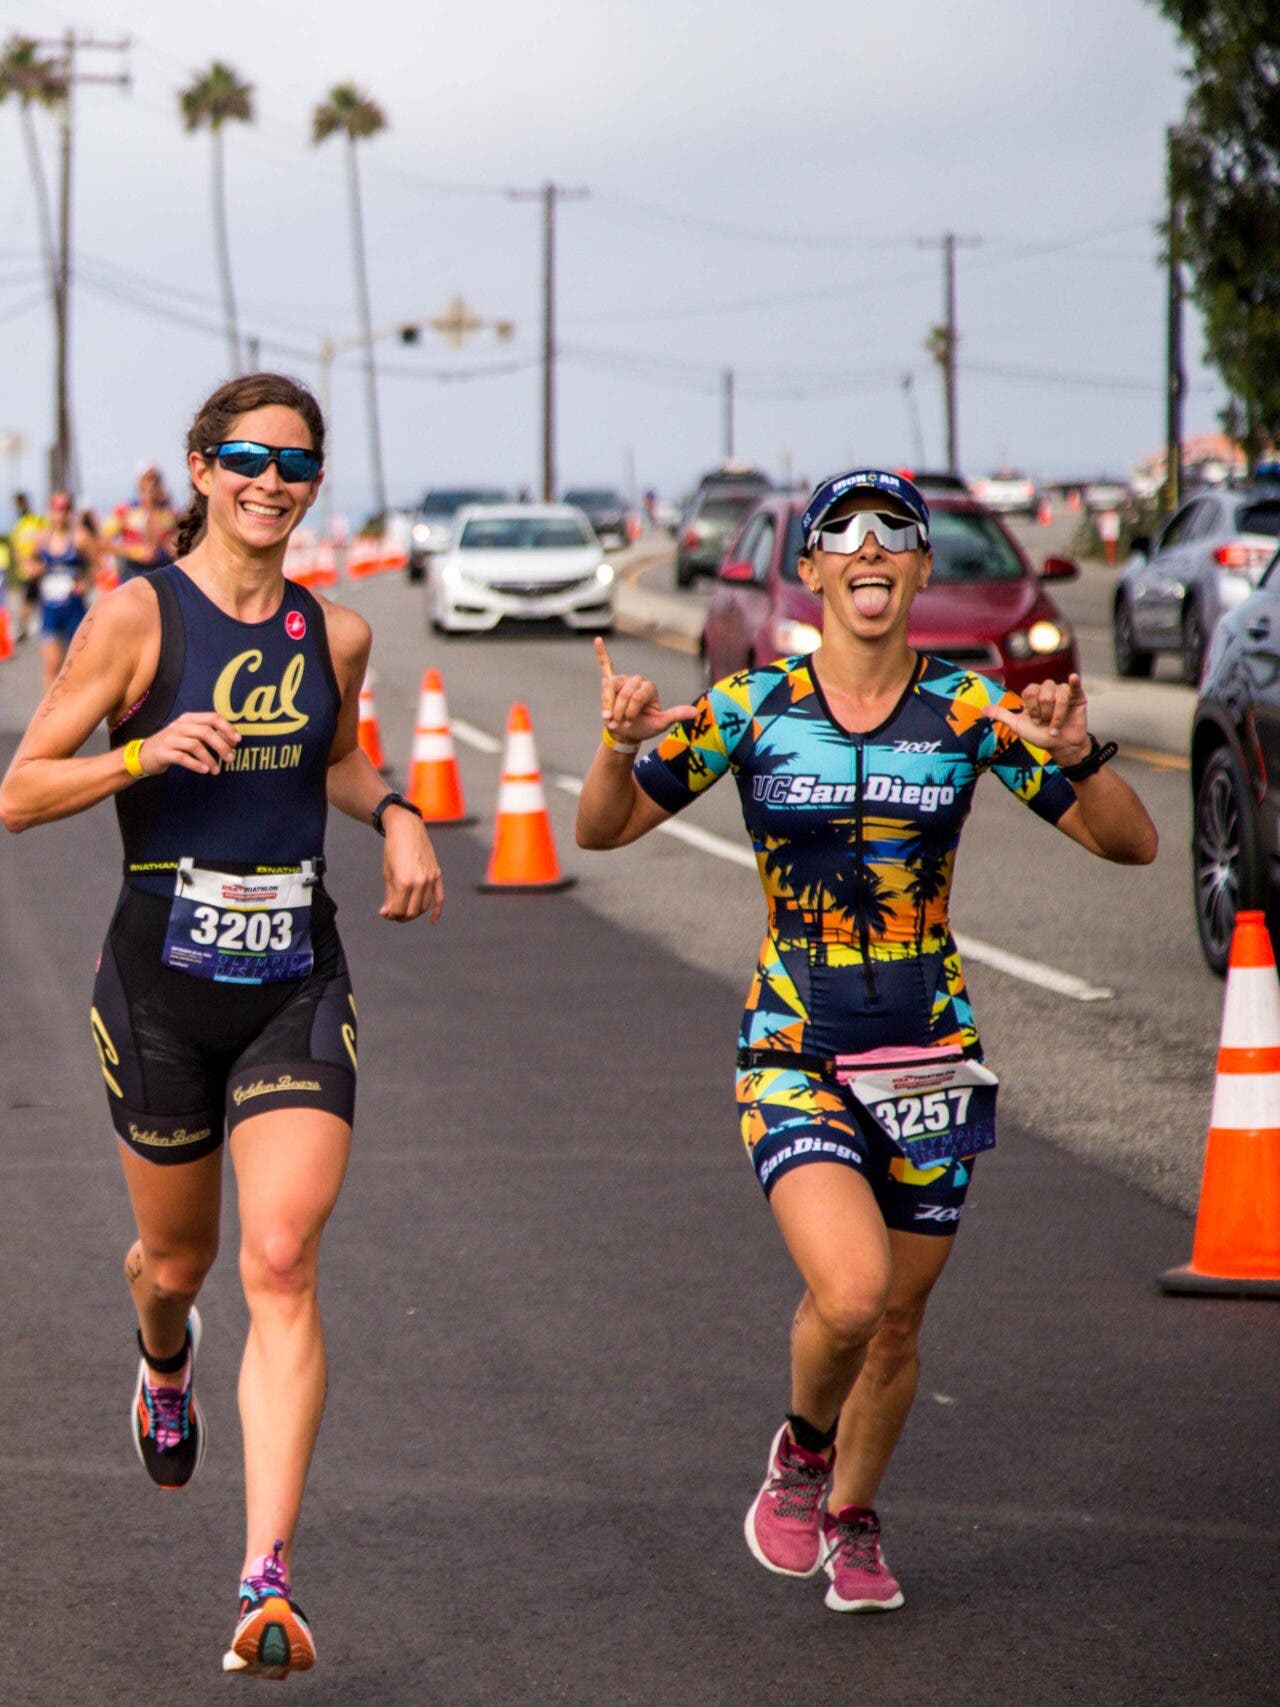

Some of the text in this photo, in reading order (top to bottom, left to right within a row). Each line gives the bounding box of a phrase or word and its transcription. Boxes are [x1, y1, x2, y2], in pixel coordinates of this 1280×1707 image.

[213, 649, 309, 736] Cal
[219, 744, 303, 773] RIATHLON
[191, 906, 293, 951] 3203
[875, 1087, 974, 1141] 3257
[792, 1137, 862, 1164] Diego
